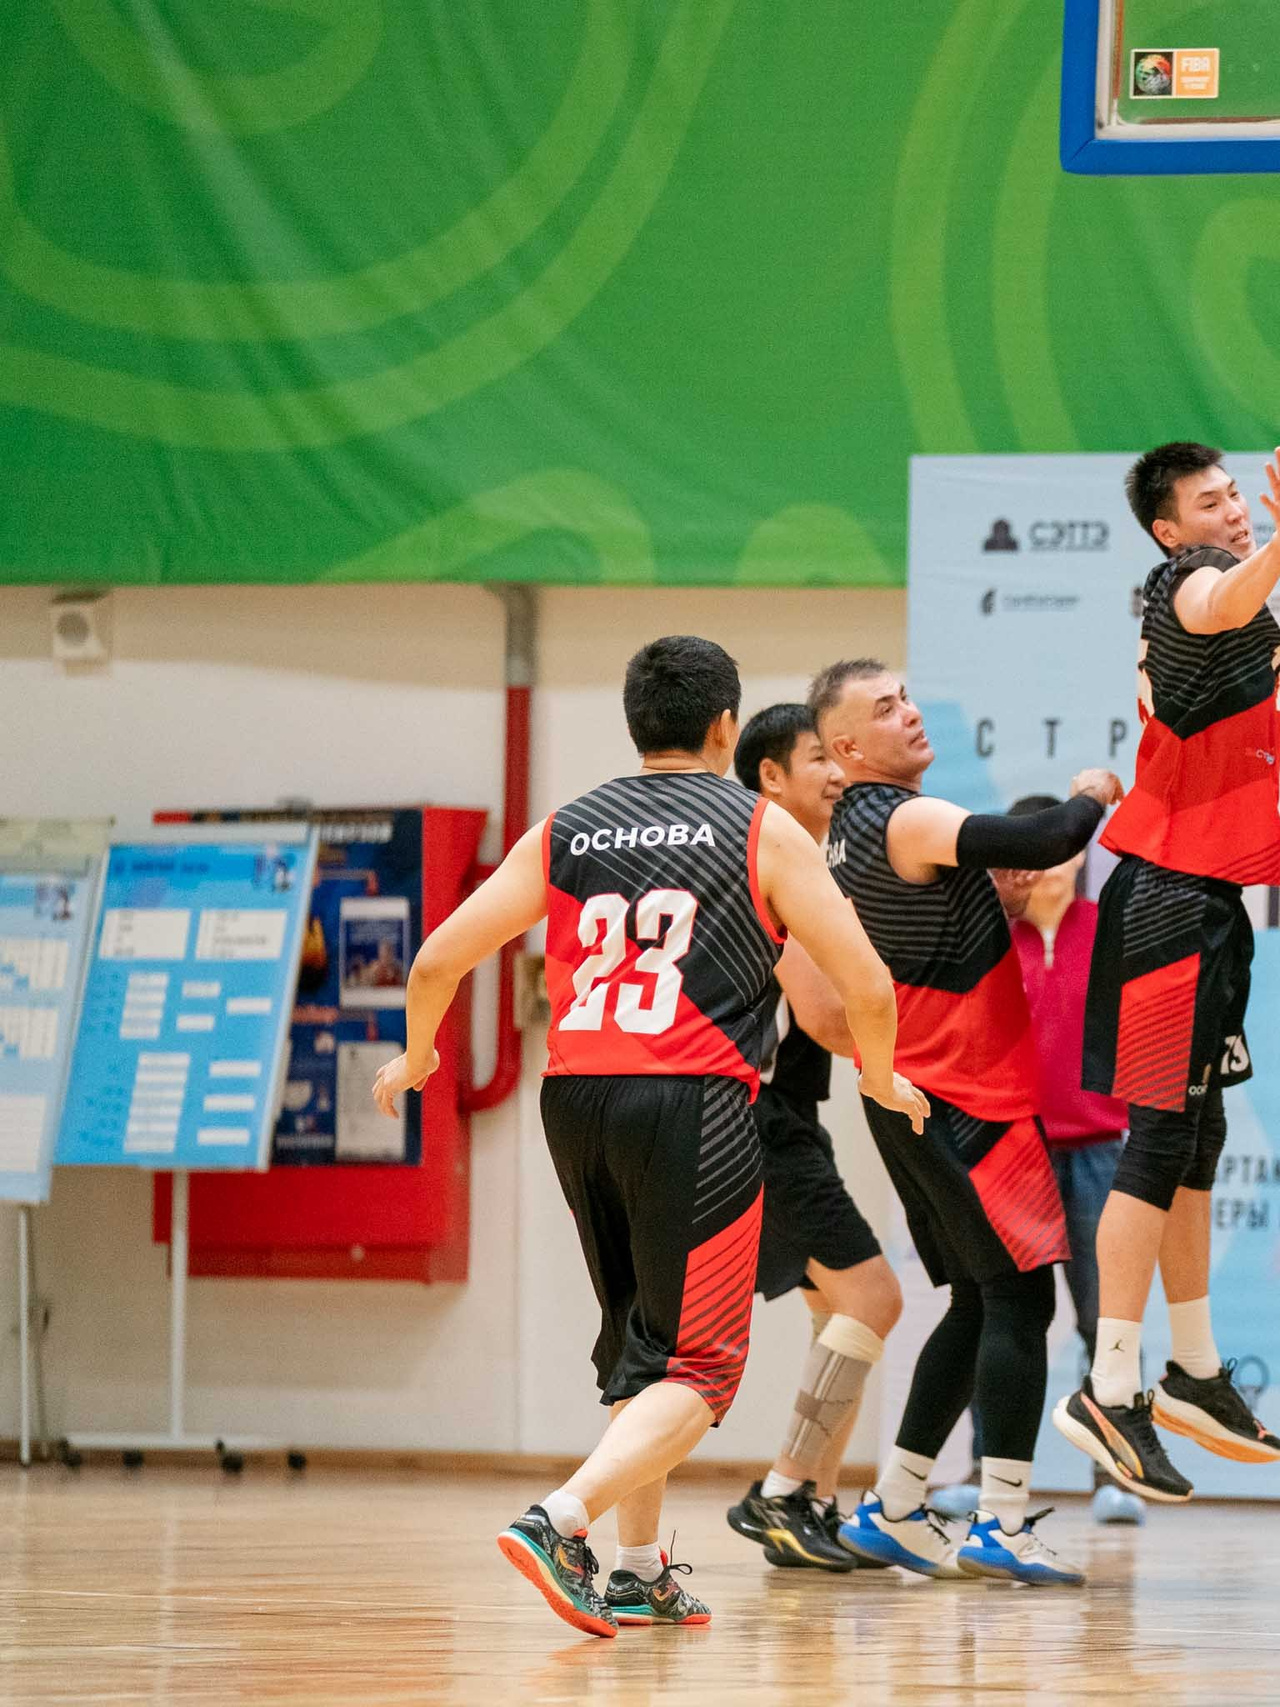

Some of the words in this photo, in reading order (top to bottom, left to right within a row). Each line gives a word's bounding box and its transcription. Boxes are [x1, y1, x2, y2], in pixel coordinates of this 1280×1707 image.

[570, 823, 717, 857] ОСНОВА
[559, 888, 698, 1035] 23
[1215, 1199, 1271, 1231] ЕРЫ
